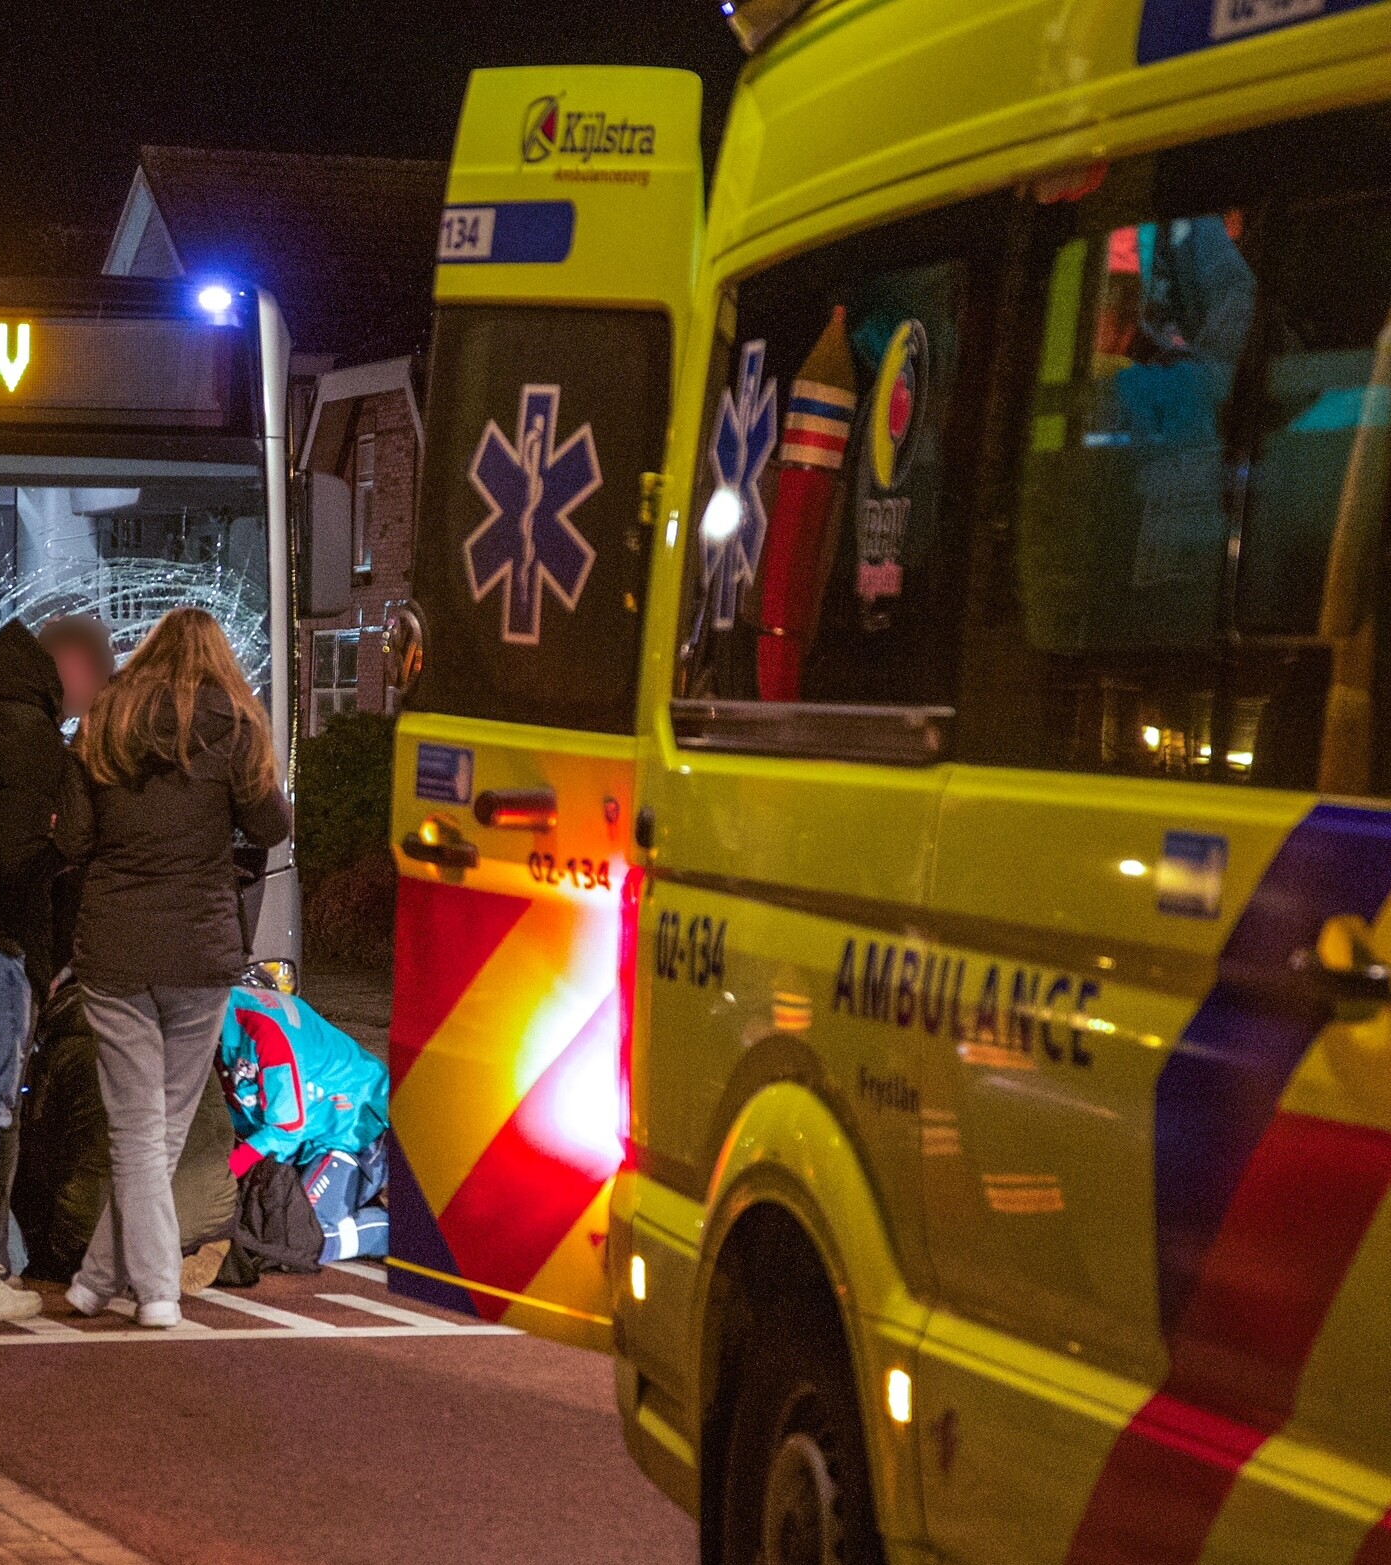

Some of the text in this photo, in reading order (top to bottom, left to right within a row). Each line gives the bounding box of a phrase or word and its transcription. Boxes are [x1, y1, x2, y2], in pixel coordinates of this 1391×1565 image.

[560, 111, 656, 163] Kijlstra
[442, 216, 480, 250] 134
[528, 852, 611, 891] 02-134
[657, 909, 728, 988] 02-134
[833, 938, 1104, 1068] AMBULANCE
